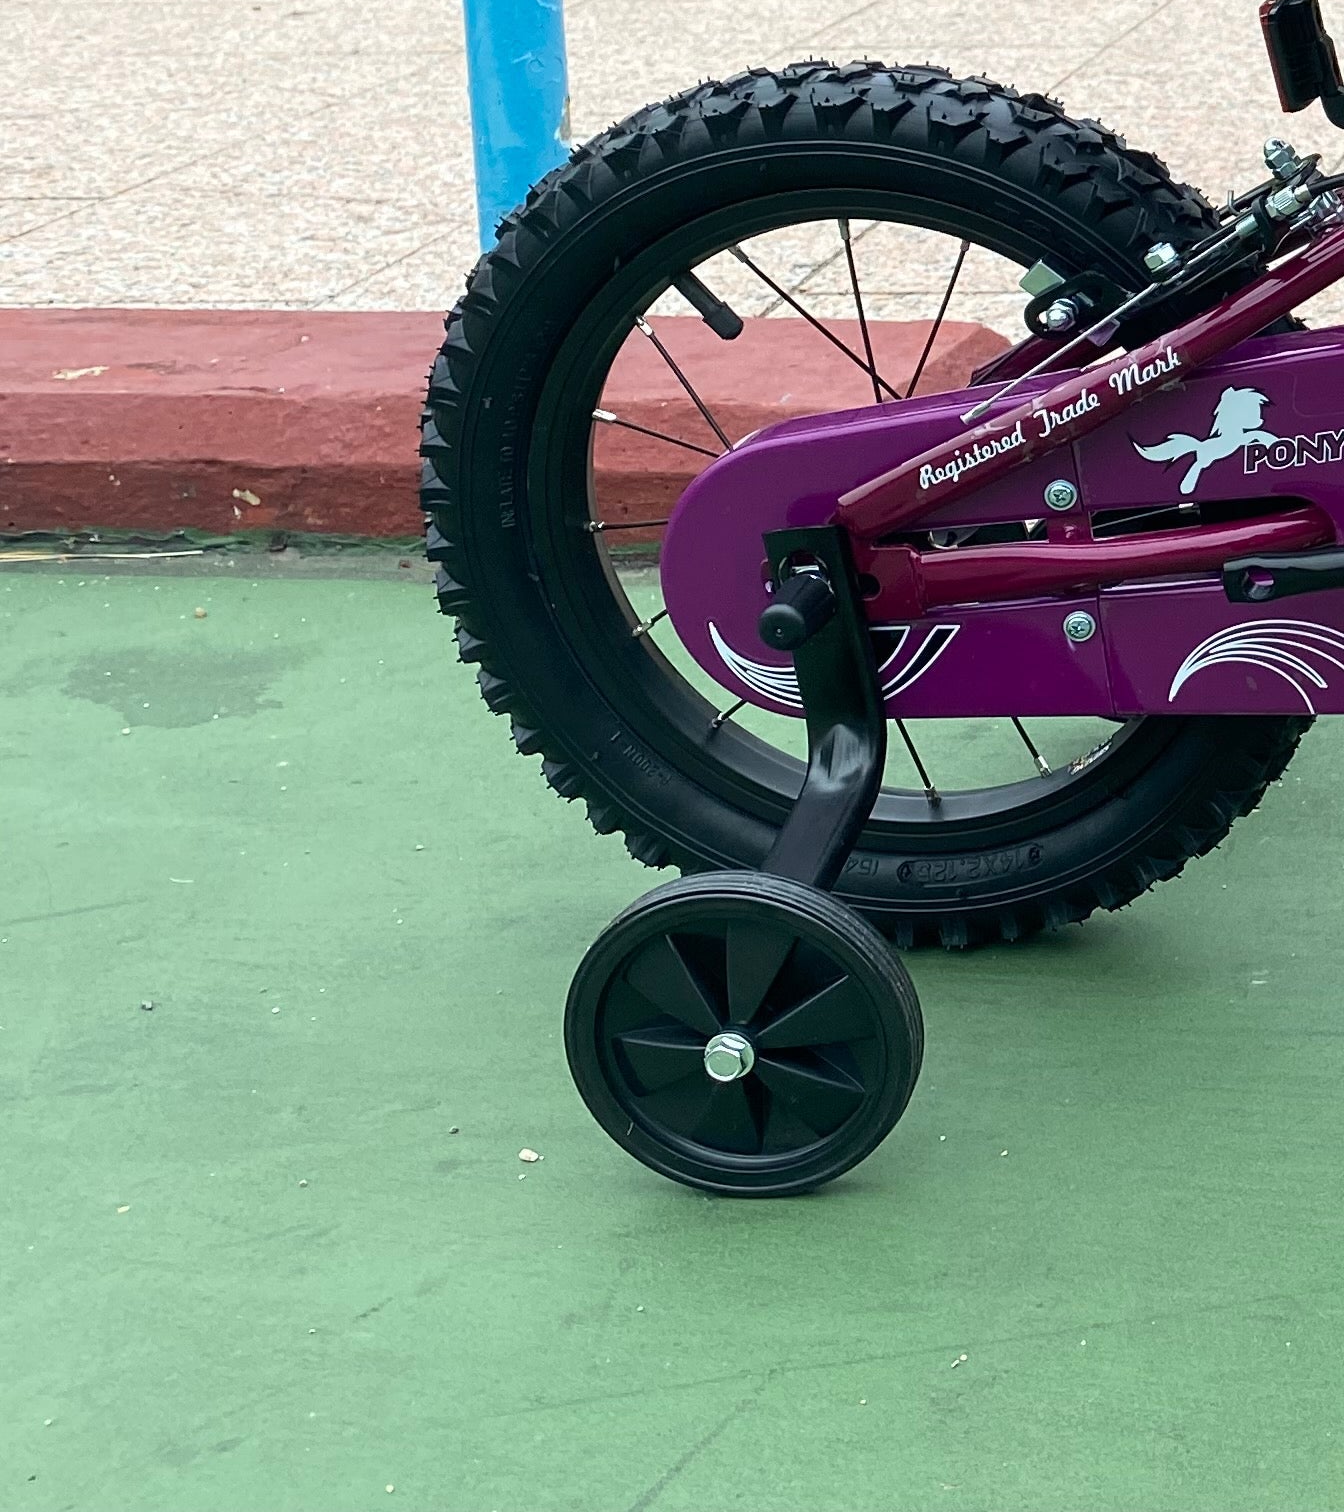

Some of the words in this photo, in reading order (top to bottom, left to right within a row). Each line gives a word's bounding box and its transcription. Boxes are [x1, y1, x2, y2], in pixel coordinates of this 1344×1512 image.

[919, 420, 1027, 490] Registered
[1033, 388, 1101, 438] Trade
[1108, 347, 1182, 396] Mark
